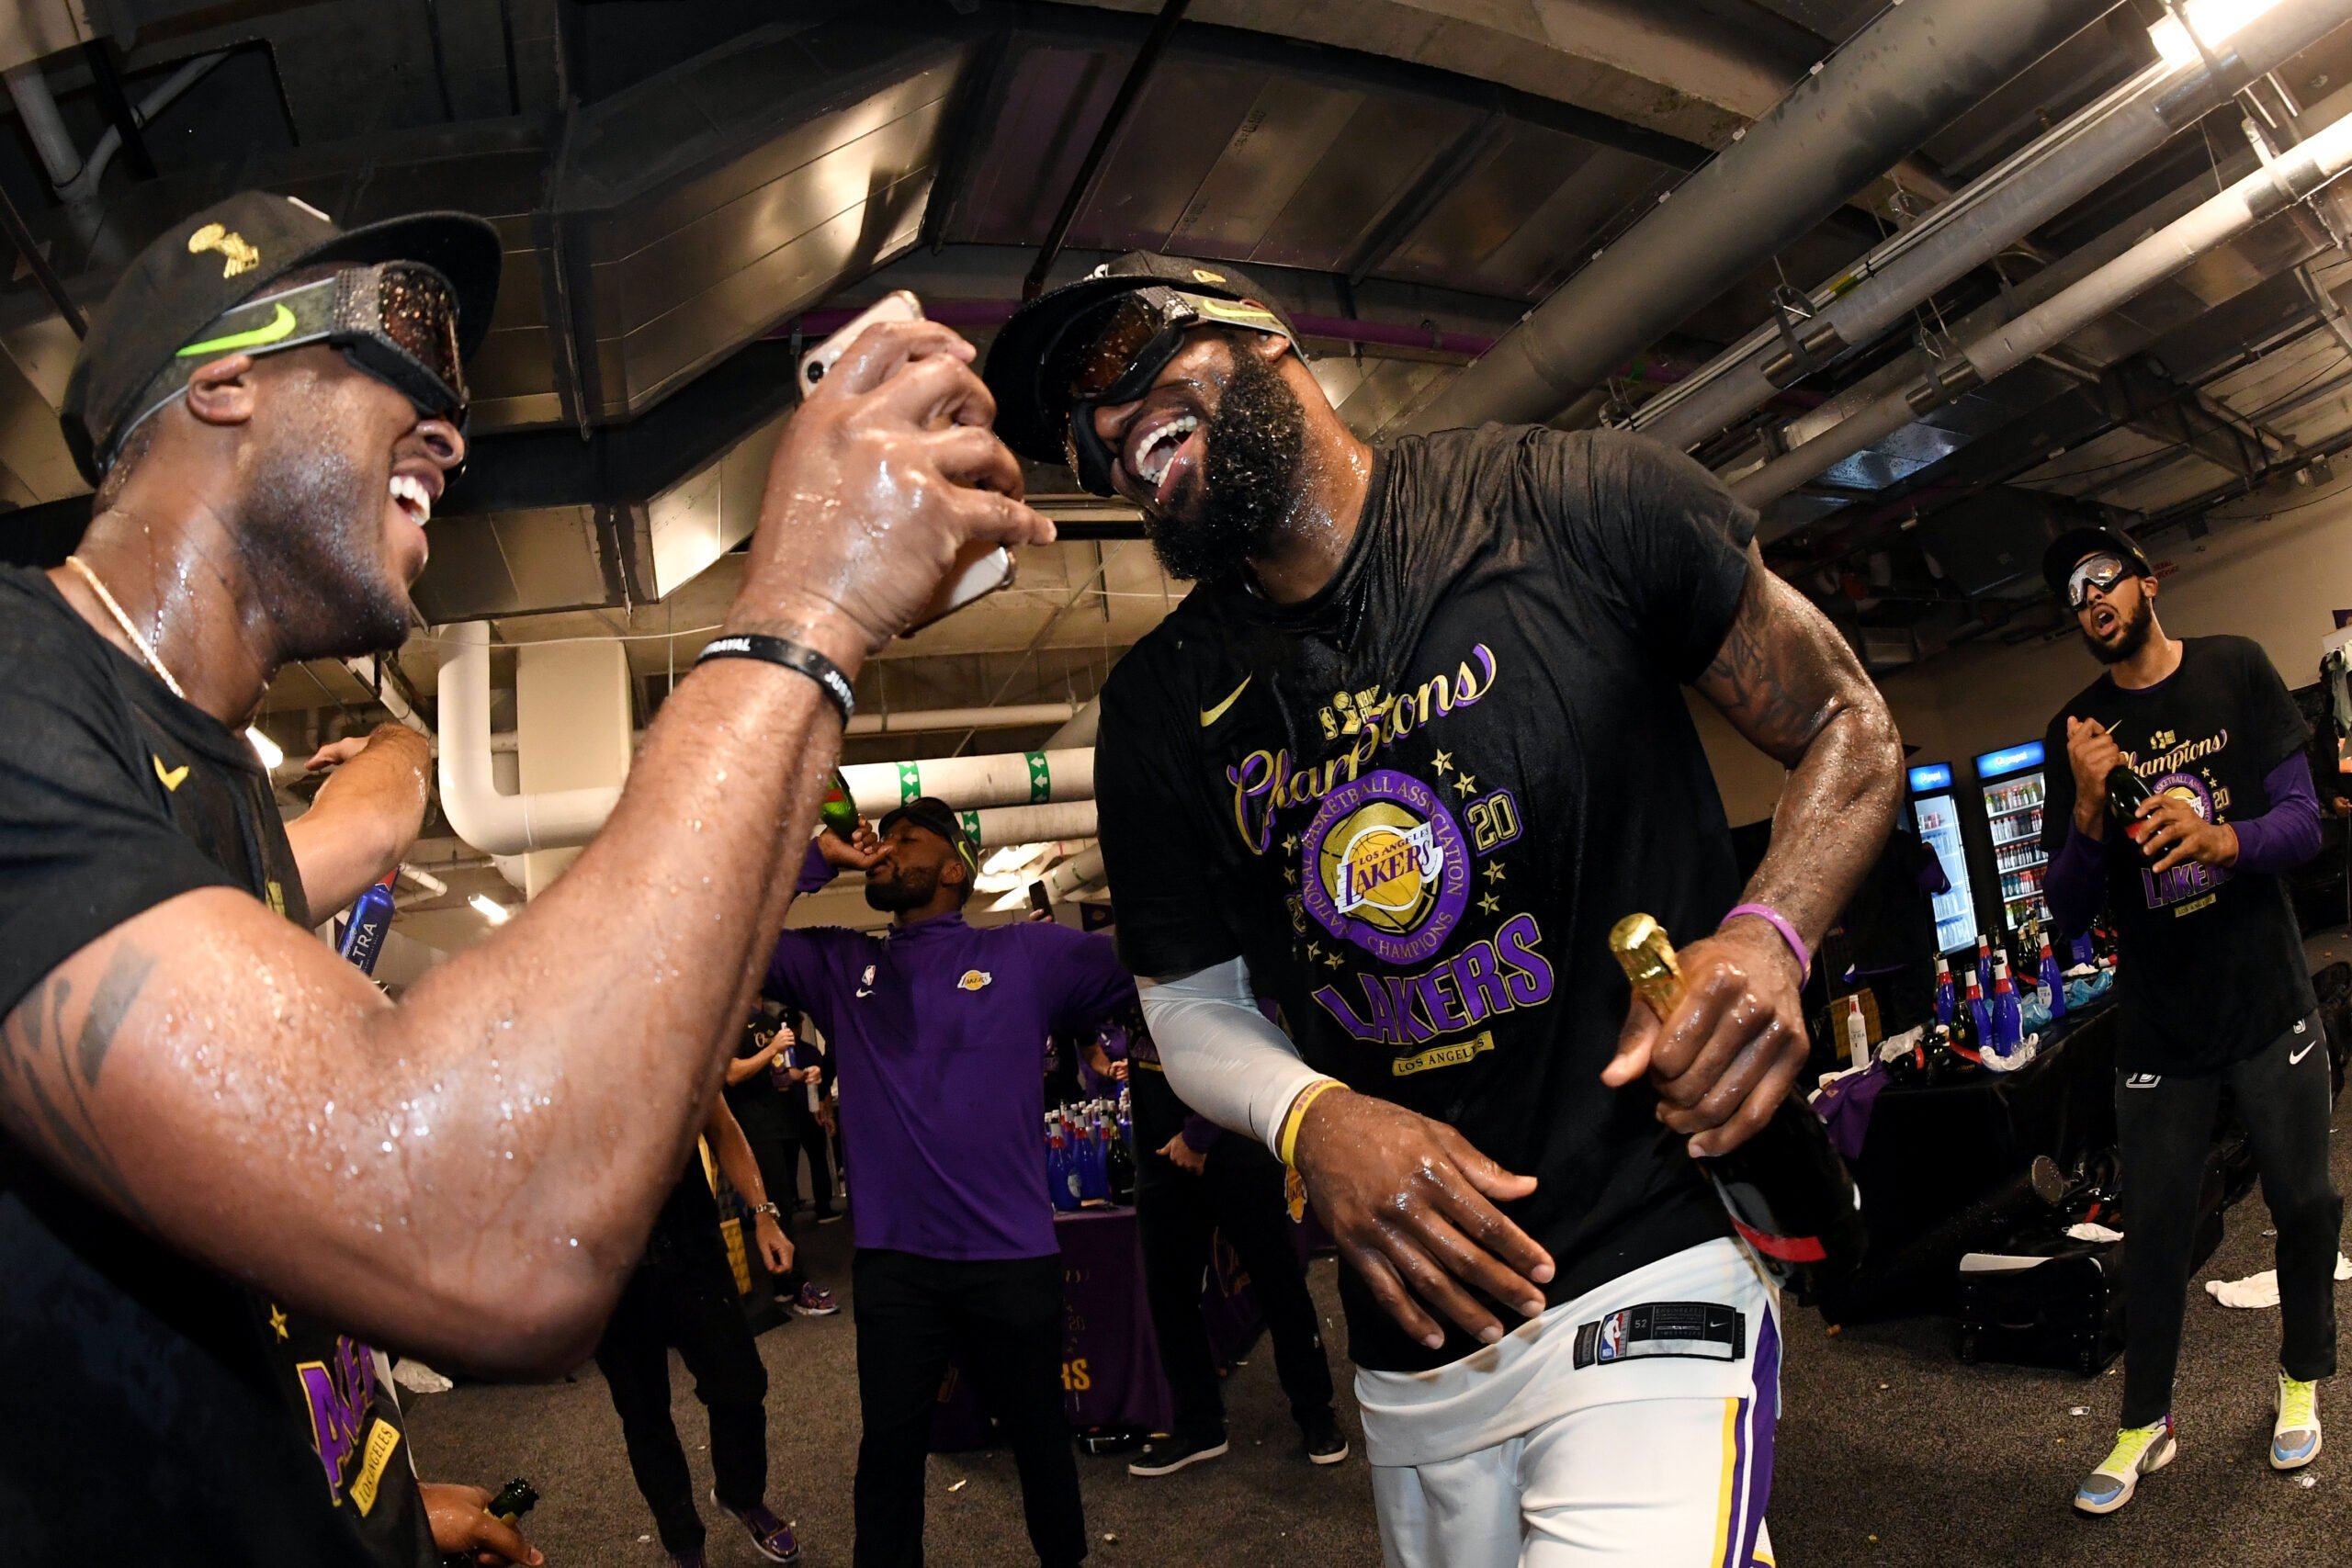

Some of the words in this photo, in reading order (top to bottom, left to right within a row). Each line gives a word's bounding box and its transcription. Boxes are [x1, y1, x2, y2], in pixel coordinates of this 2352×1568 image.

[2154, 774, 2188, 795] SKETBALL
[2212, 787, 2231, 810] 20
[1303, 775, 1395, 850] BASKETBALL
[1396, 780, 1465, 897] ASSOCIATION
[1464, 789, 1522, 857] 20
[1342, 840, 1438, 908] LAKERS
[1360, 851, 1380, 865] LOS
[351, 922, 378, 970] LTRA
[1367, 910, 1454, 960] CHAMPIONS
[1312, 911, 1555, 1045] LAKERS
[1398, 1057, 1424, 1073] LOS
[1634, 1319, 1647, 1329] 52
